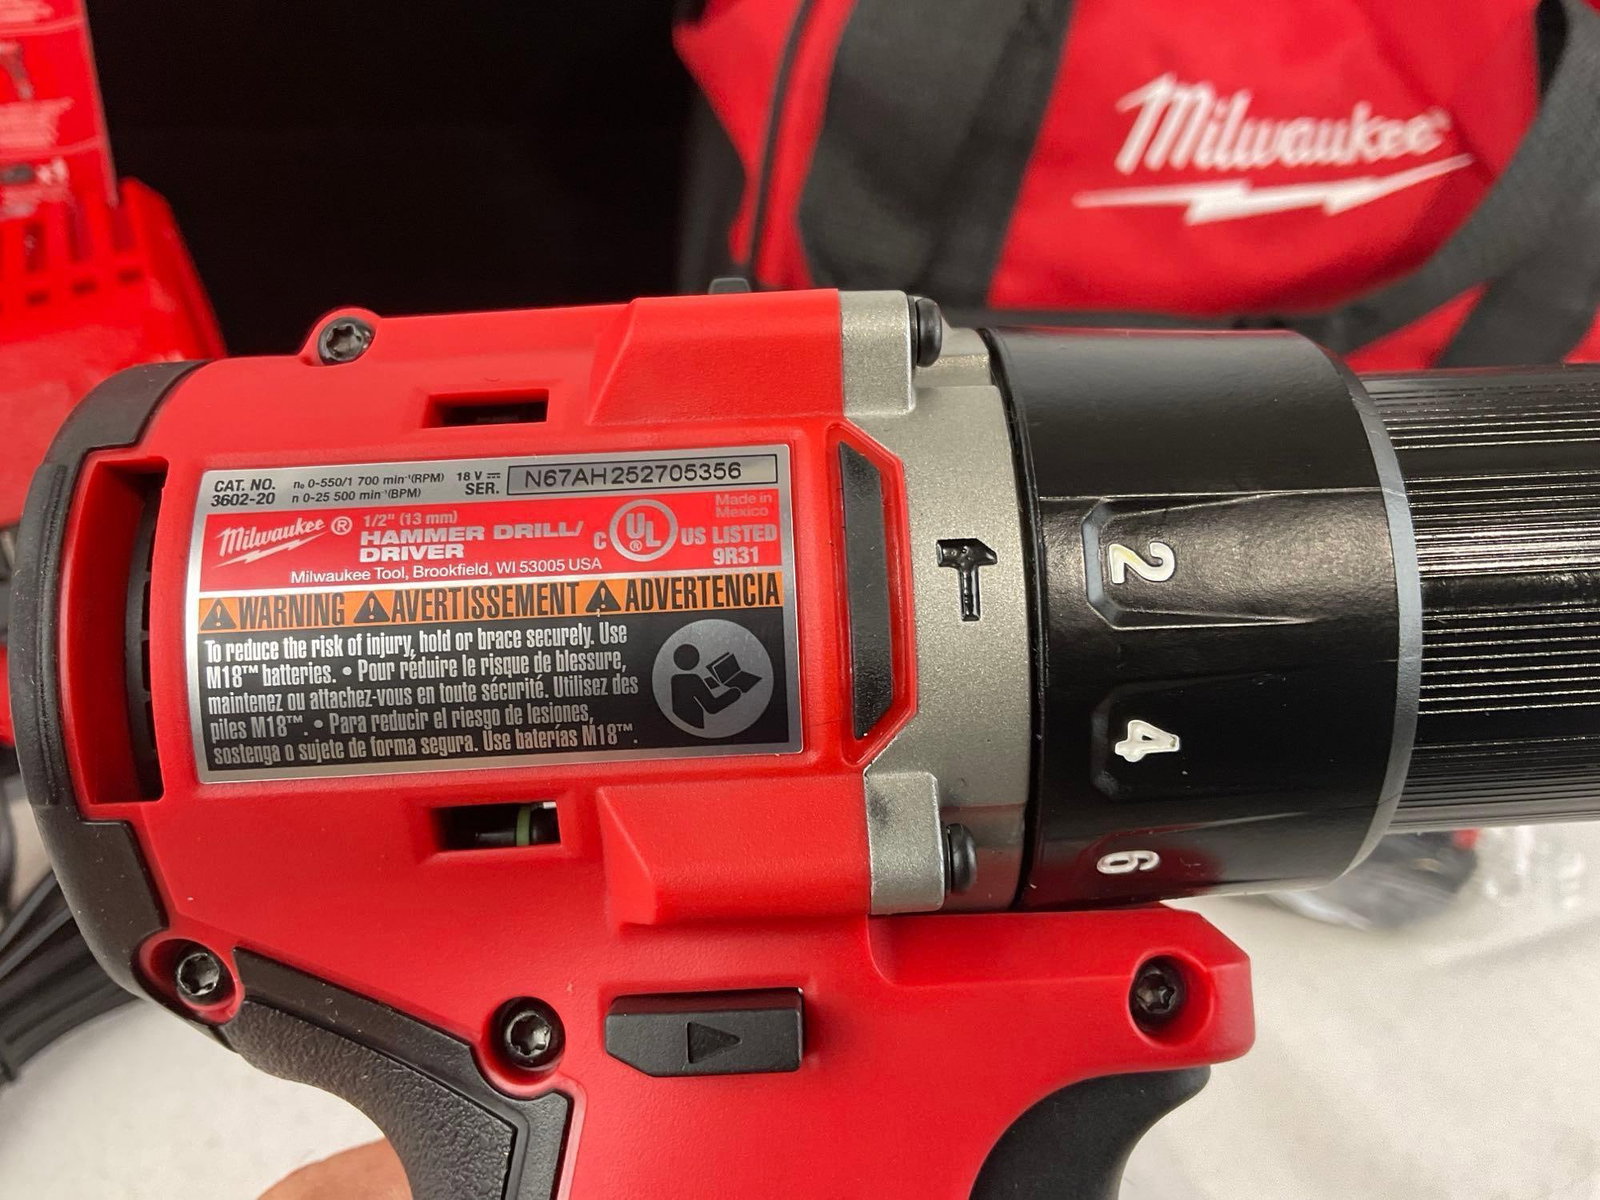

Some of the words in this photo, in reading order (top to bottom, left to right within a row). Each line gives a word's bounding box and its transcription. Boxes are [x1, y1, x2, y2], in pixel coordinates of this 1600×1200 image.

[1115, 72, 1452, 175] Milwaukee
[214, 480, 245, 492] CAT.
[250, 478, 276, 491] NO.
[358, 475, 380, 486] 700
[456, 471, 471, 482] 18
[474, 471, 483, 481] V
[525, 461, 742, 488] N67AH252705356
[211, 492, 276, 507] 3602-20
[303, 491, 330, 503] 0-25
[333, 490, 356, 502] 500
[465, 481, 499, 496] SER.
[715, 493, 756, 507] Made
[759, 492, 773, 504] in
[363, 513, 395, 528] 1/2"
[400, 512, 422, 527] (13
[425, 510, 458, 526] mm)
[715, 506, 769, 519] Mexico
[216, 517, 325, 557] Milwaukee
[361, 525, 485, 546] HAMMER
[493, 521, 584, 540] DRILL/
[593, 532, 607, 550] C
[681, 527, 706, 545] US
[712, 523, 778, 544] LISTED
[359, 543, 464, 563] DRIVER
[712, 546, 760, 566] 9R31
[1108, 541, 1176, 584] 2
[290, 569, 371, 584] Milwaukee
[376, 566, 409, 581] Tool,
[412, 562, 493, 579] Brookfield,
[496, 561, 516, 574] WI
[519, 559, 565, 573] 53005
[569, 556, 603, 571] USA
[238, 591, 346, 630] WARNING
[391, 580, 580, 624] AVERTISSEMENT
[624, 571, 781, 612] ADVERTENCIA
[205, 639, 222, 663] To
[226, 638, 279, 662] reduce
[283, 636, 307, 660] the
[311, 634, 344, 658] risk
[348, 633, 363, 657] of
[366, 631, 417, 660] injury,
[419, 629, 451, 653] hold
[455, 631, 473, 652] or
[477, 627, 522, 651] brace
[526, 623, 595, 649] securely.
[598, 621, 628, 644] Use
[262, 661, 337, 687] batteries.
[357, 659, 395, 682] Pour
[399, 656, 458, 680] réduire
[462, 654, 477, 677] le
[480, 652, 530, 679] risque
[533, 650, 552, 673] de
[555, 649, 627, 673] blessure,
[208, 691, 283, 715] maintenez
[287, 690, 306, 711] ou
[309, 685, 413, 710] attachez-vous
[417, 686, 436, 705] en
[439, 681, 477, 704] toute
[481, 675, 550, 702] sécurité.
[553, 673, 609, 698] Utilisez
[612, 672, 639, 695] des
[210, 718, 248, 744] piles
[328, 711, 367, 735] Para
[371, 708, 430, 732] reducir
[433, 707, 448, 730] el
[451, 706, 501, 731] riesgo
[504, 703, 523, 726] de
[526, 701, 594, 726] lesiones,
[213, 743, 281, 767] sostenga
[284, 743, 295, 762] o
[299, 738, 345, 764] sujete
[348, 737, 367, 758] de
[370, 735, 418, 757] forma
[421, 735, 479, 757] segura.
[482, 729, 511, 751] Use
[515, 723, 578, 750] baterías
[1114, 719, 1181, 763] 4
[1096, 849, 1160, 875] 6
